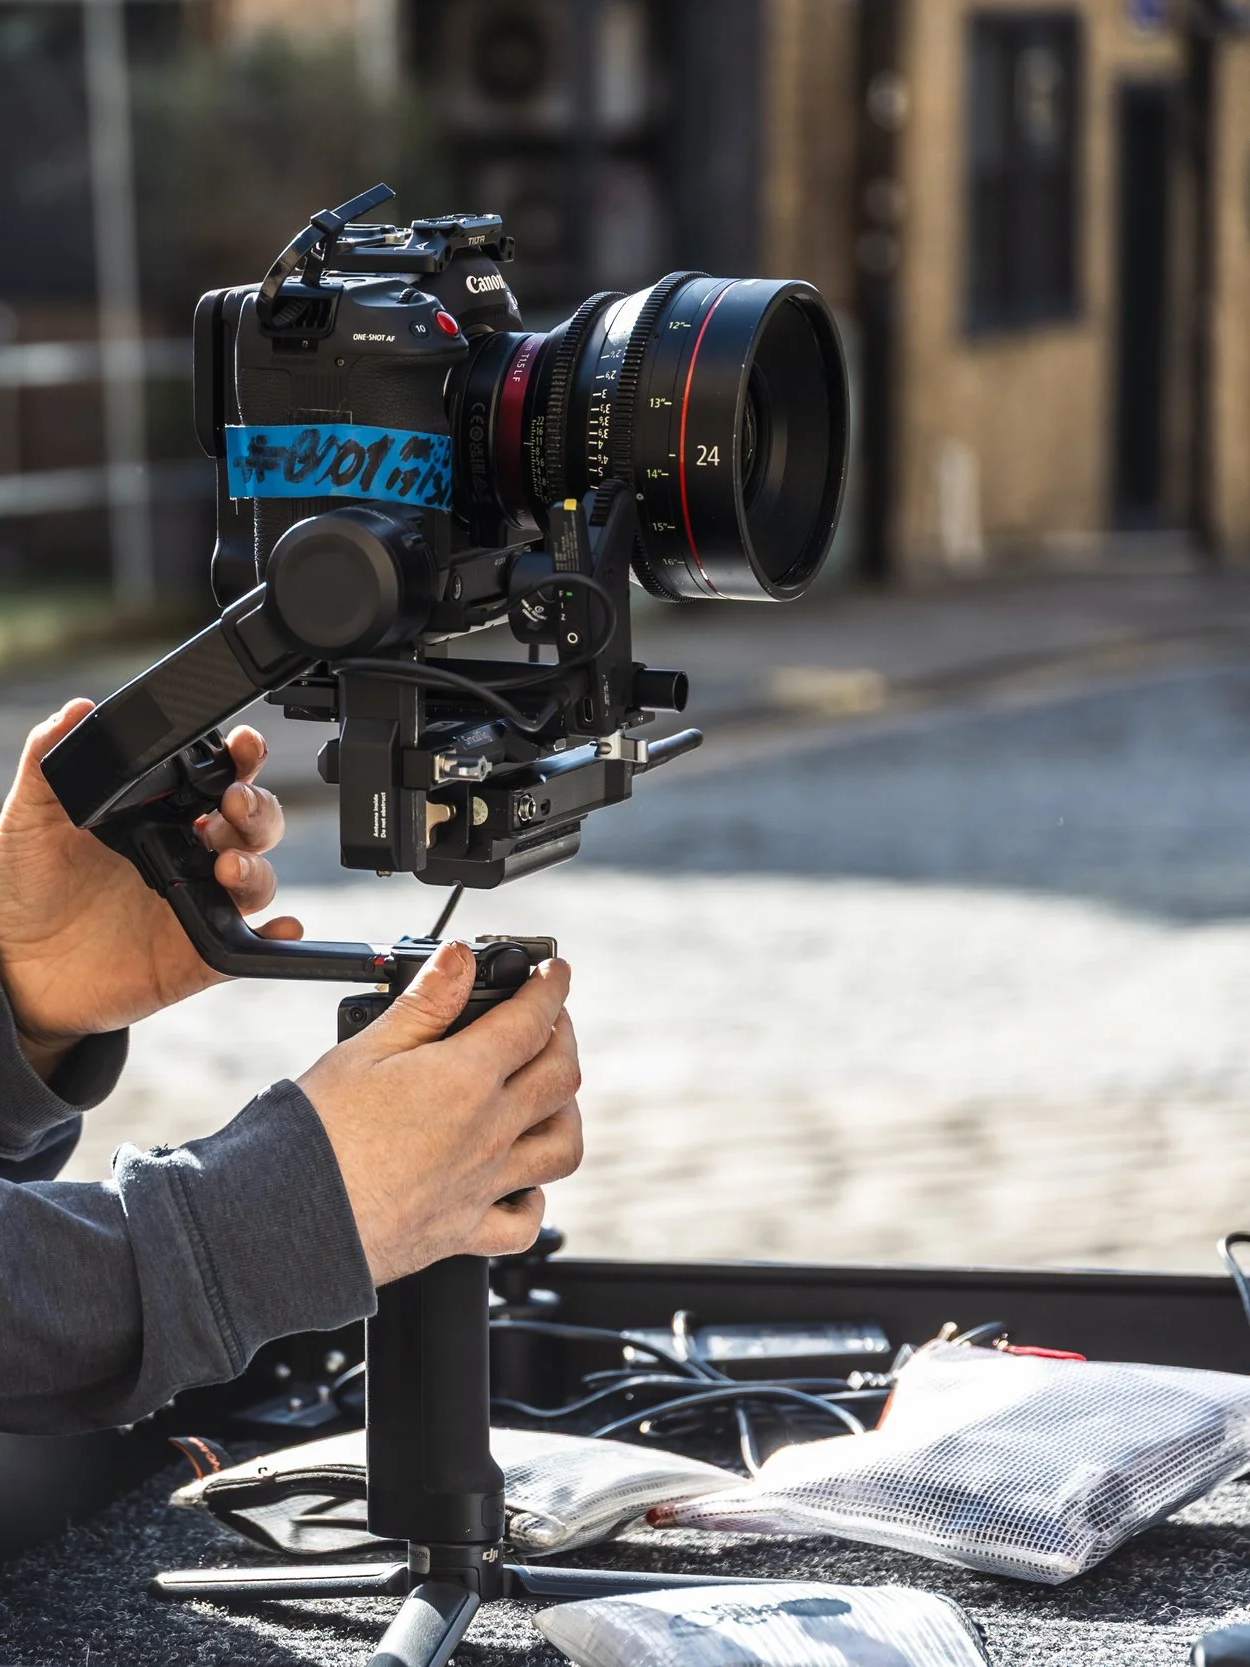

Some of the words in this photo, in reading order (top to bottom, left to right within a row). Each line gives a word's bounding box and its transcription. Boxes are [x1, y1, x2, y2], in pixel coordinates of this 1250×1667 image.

[468, 235, 486, 245] TILTA
[466, 274, 506, 294] Canon
[415, 324, 426, 333] 10
[352, 333, 385, 342] ONE-SHOT
[696, 444, 720, 466] 24
[381, 828, 387, 838] Do
